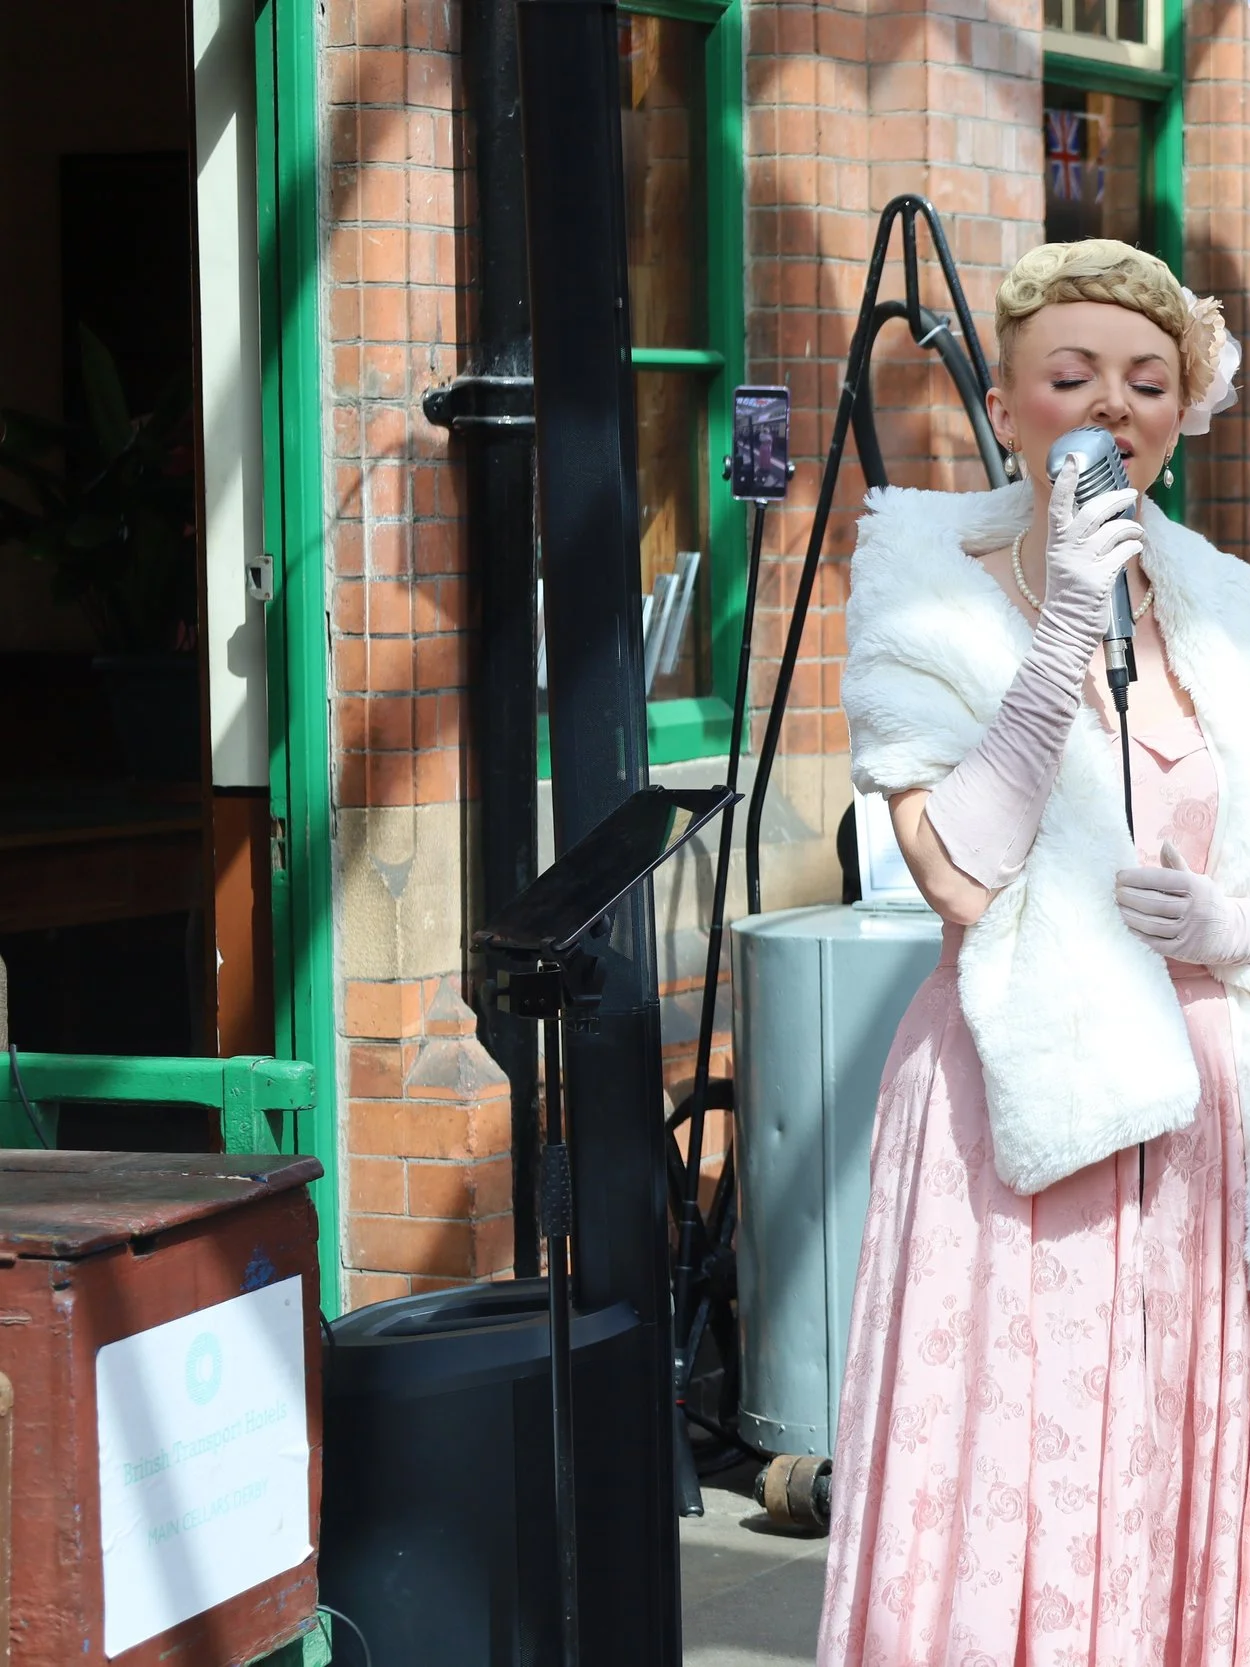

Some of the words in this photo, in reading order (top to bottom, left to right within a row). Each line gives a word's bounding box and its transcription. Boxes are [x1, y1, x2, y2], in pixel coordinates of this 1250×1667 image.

[123, 1448, 172, 1486] British
[172, 1420, 242, 1464] Transport
[244, 1399, 288, 1435] Hotels
[148, 1519, 180, 1547] MAIN
[182, 1494, 230, 1530] CELLARS
[233, 1475, 269, 1507] DERBY
